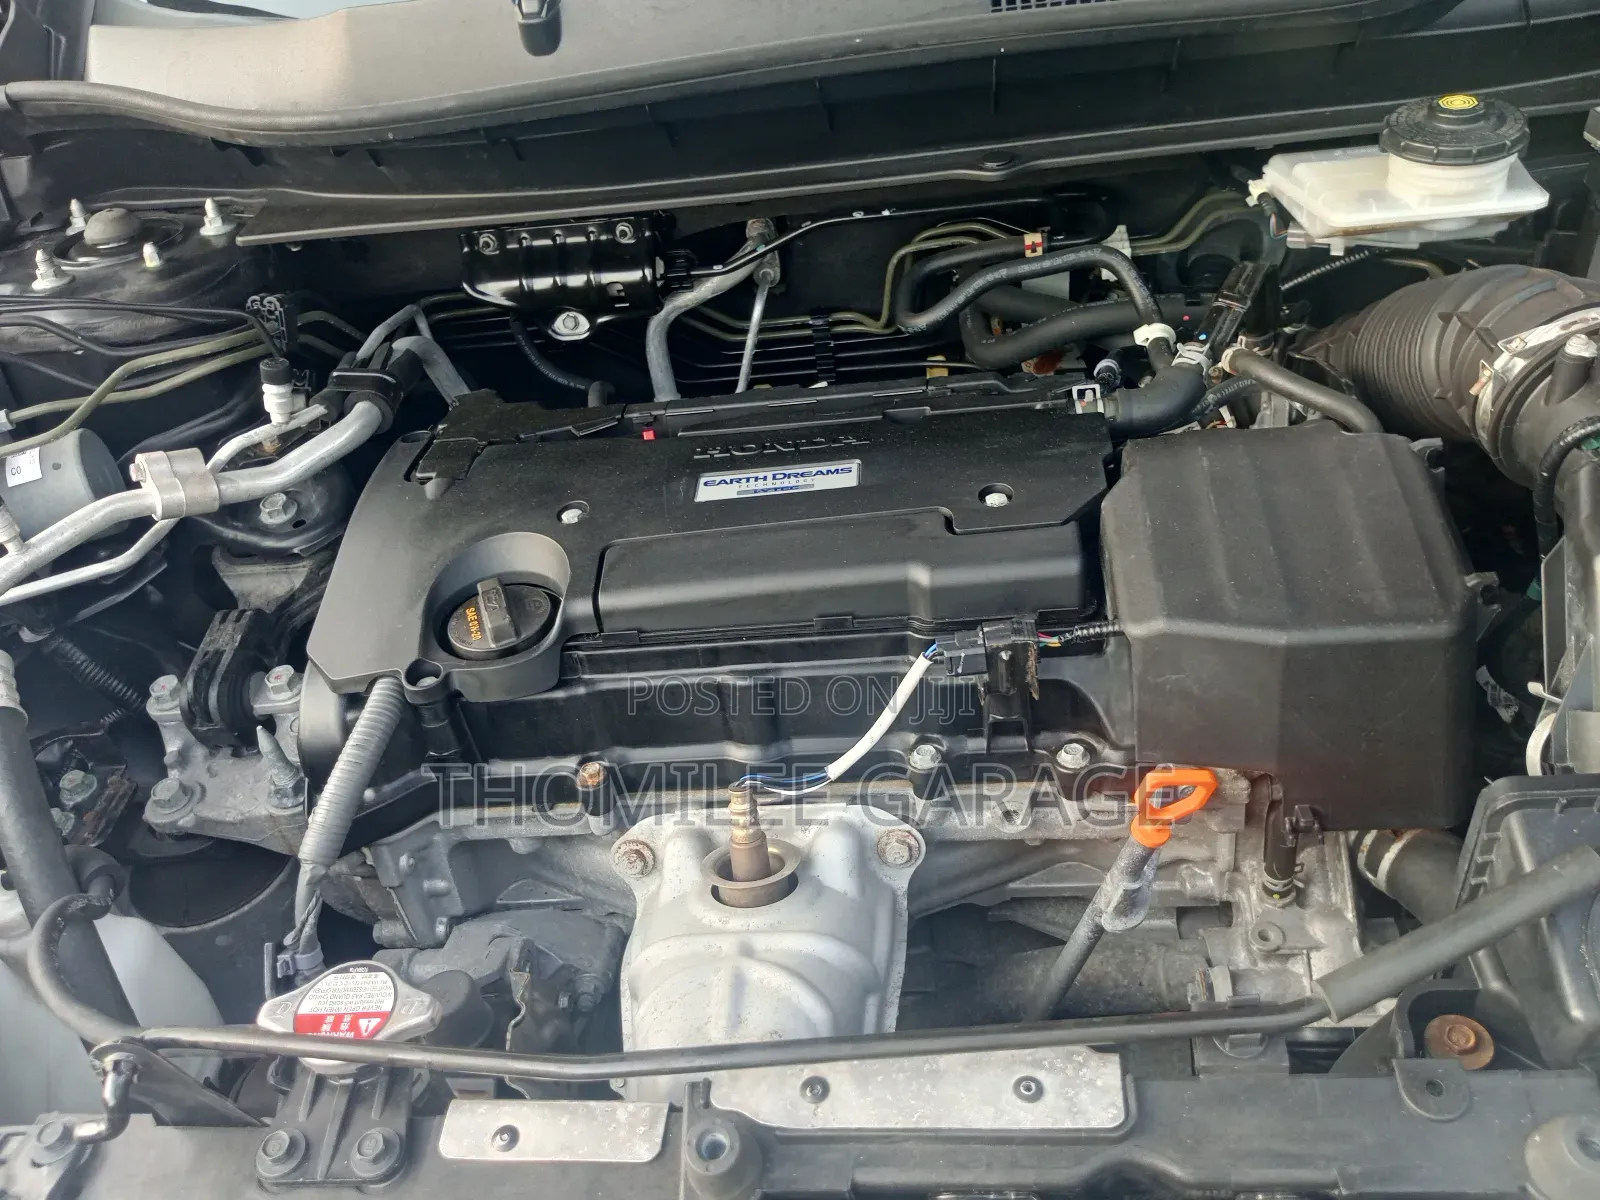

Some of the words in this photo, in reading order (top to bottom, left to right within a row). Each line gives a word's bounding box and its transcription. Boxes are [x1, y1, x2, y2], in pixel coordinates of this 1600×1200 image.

[703, 474, 768, 487] EARTH
[771, 466, 853, 481] DREAMS
[738, 478, 816, 489] TECHNOLOGY
[465, 607, 479, 622] SAE
